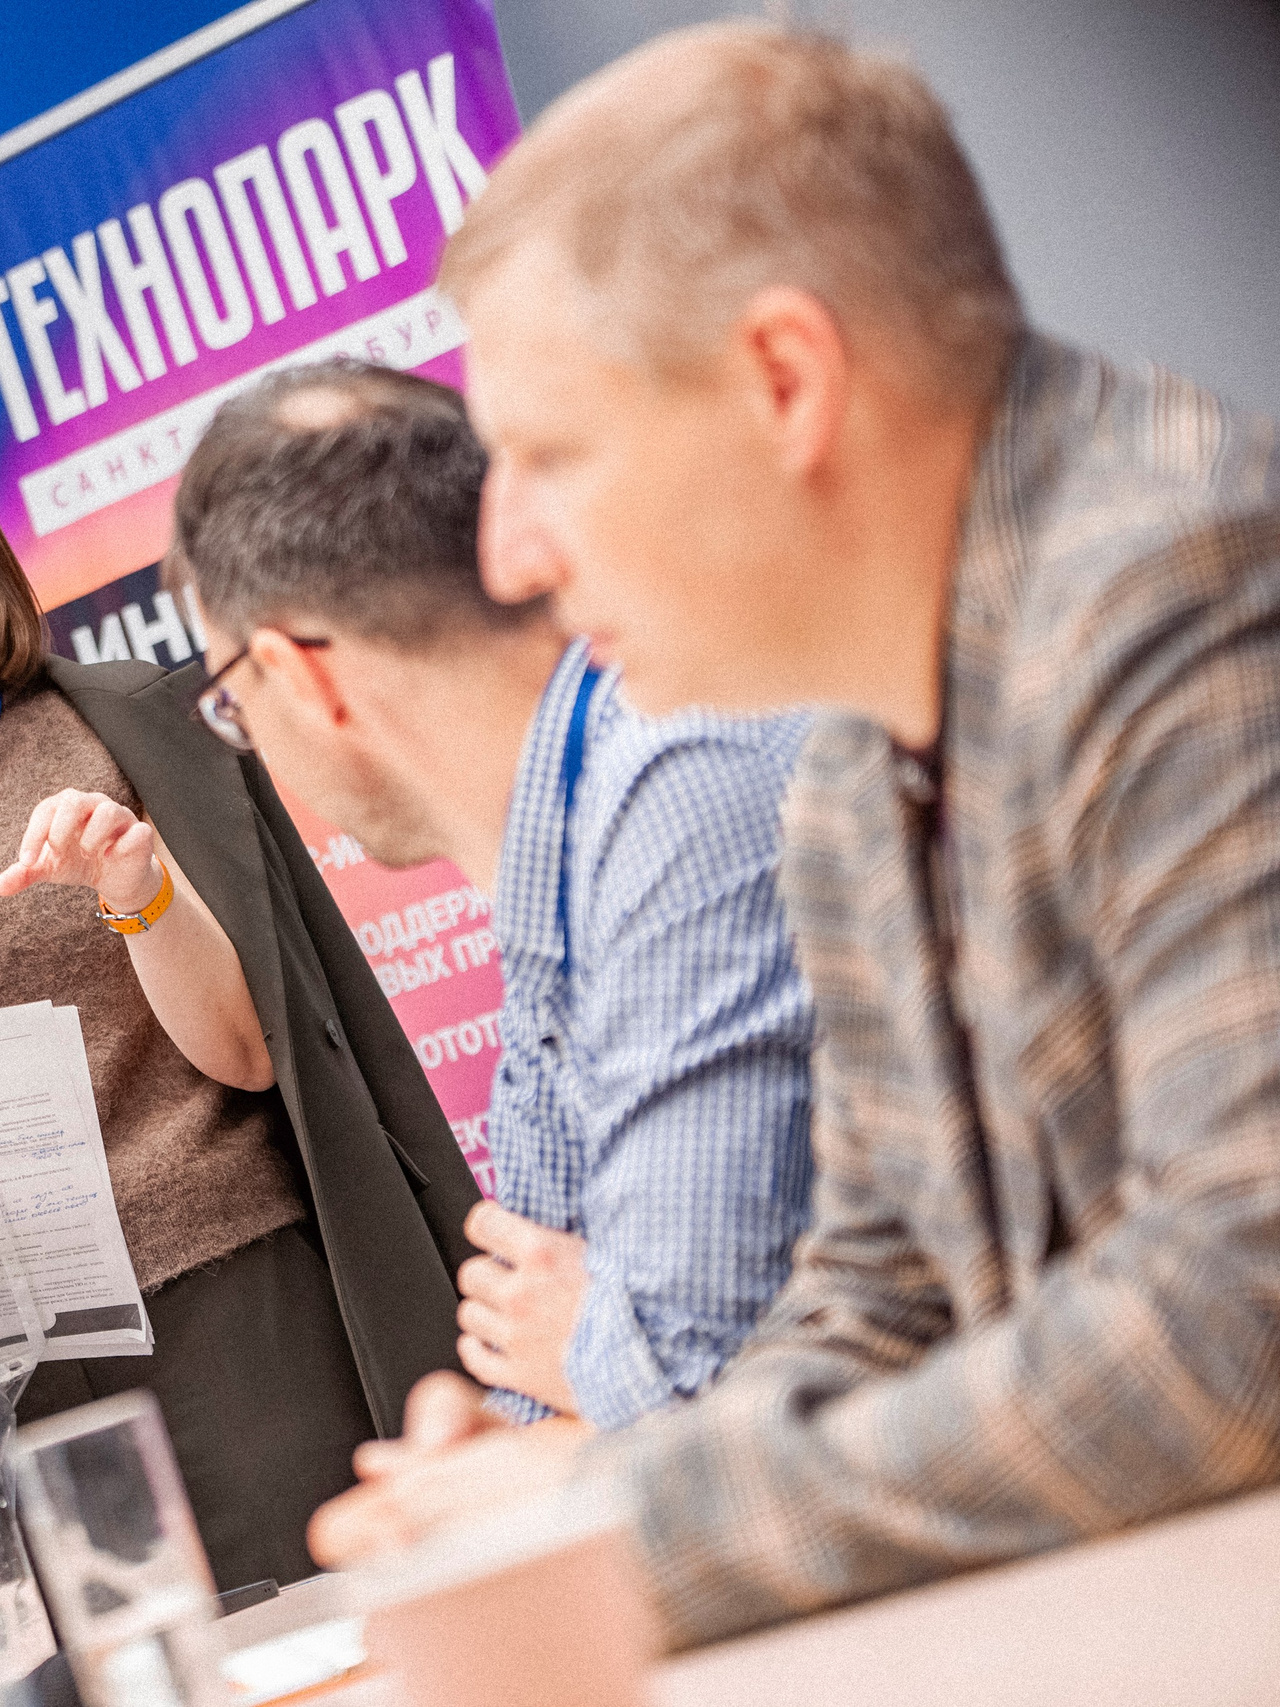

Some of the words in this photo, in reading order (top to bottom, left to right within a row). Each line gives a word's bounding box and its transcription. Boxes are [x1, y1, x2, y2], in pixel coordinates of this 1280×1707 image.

[50, 426, 182, 509] САНКТ
[70, 583, 209, 665] ИН
[375, 945, 452, 999] ВЫХ
[450, 927, 499, 972] ПР
[416, 1011, 501, 1070] ОТОТ
[450, 1115, 490, 1155] ЕК
